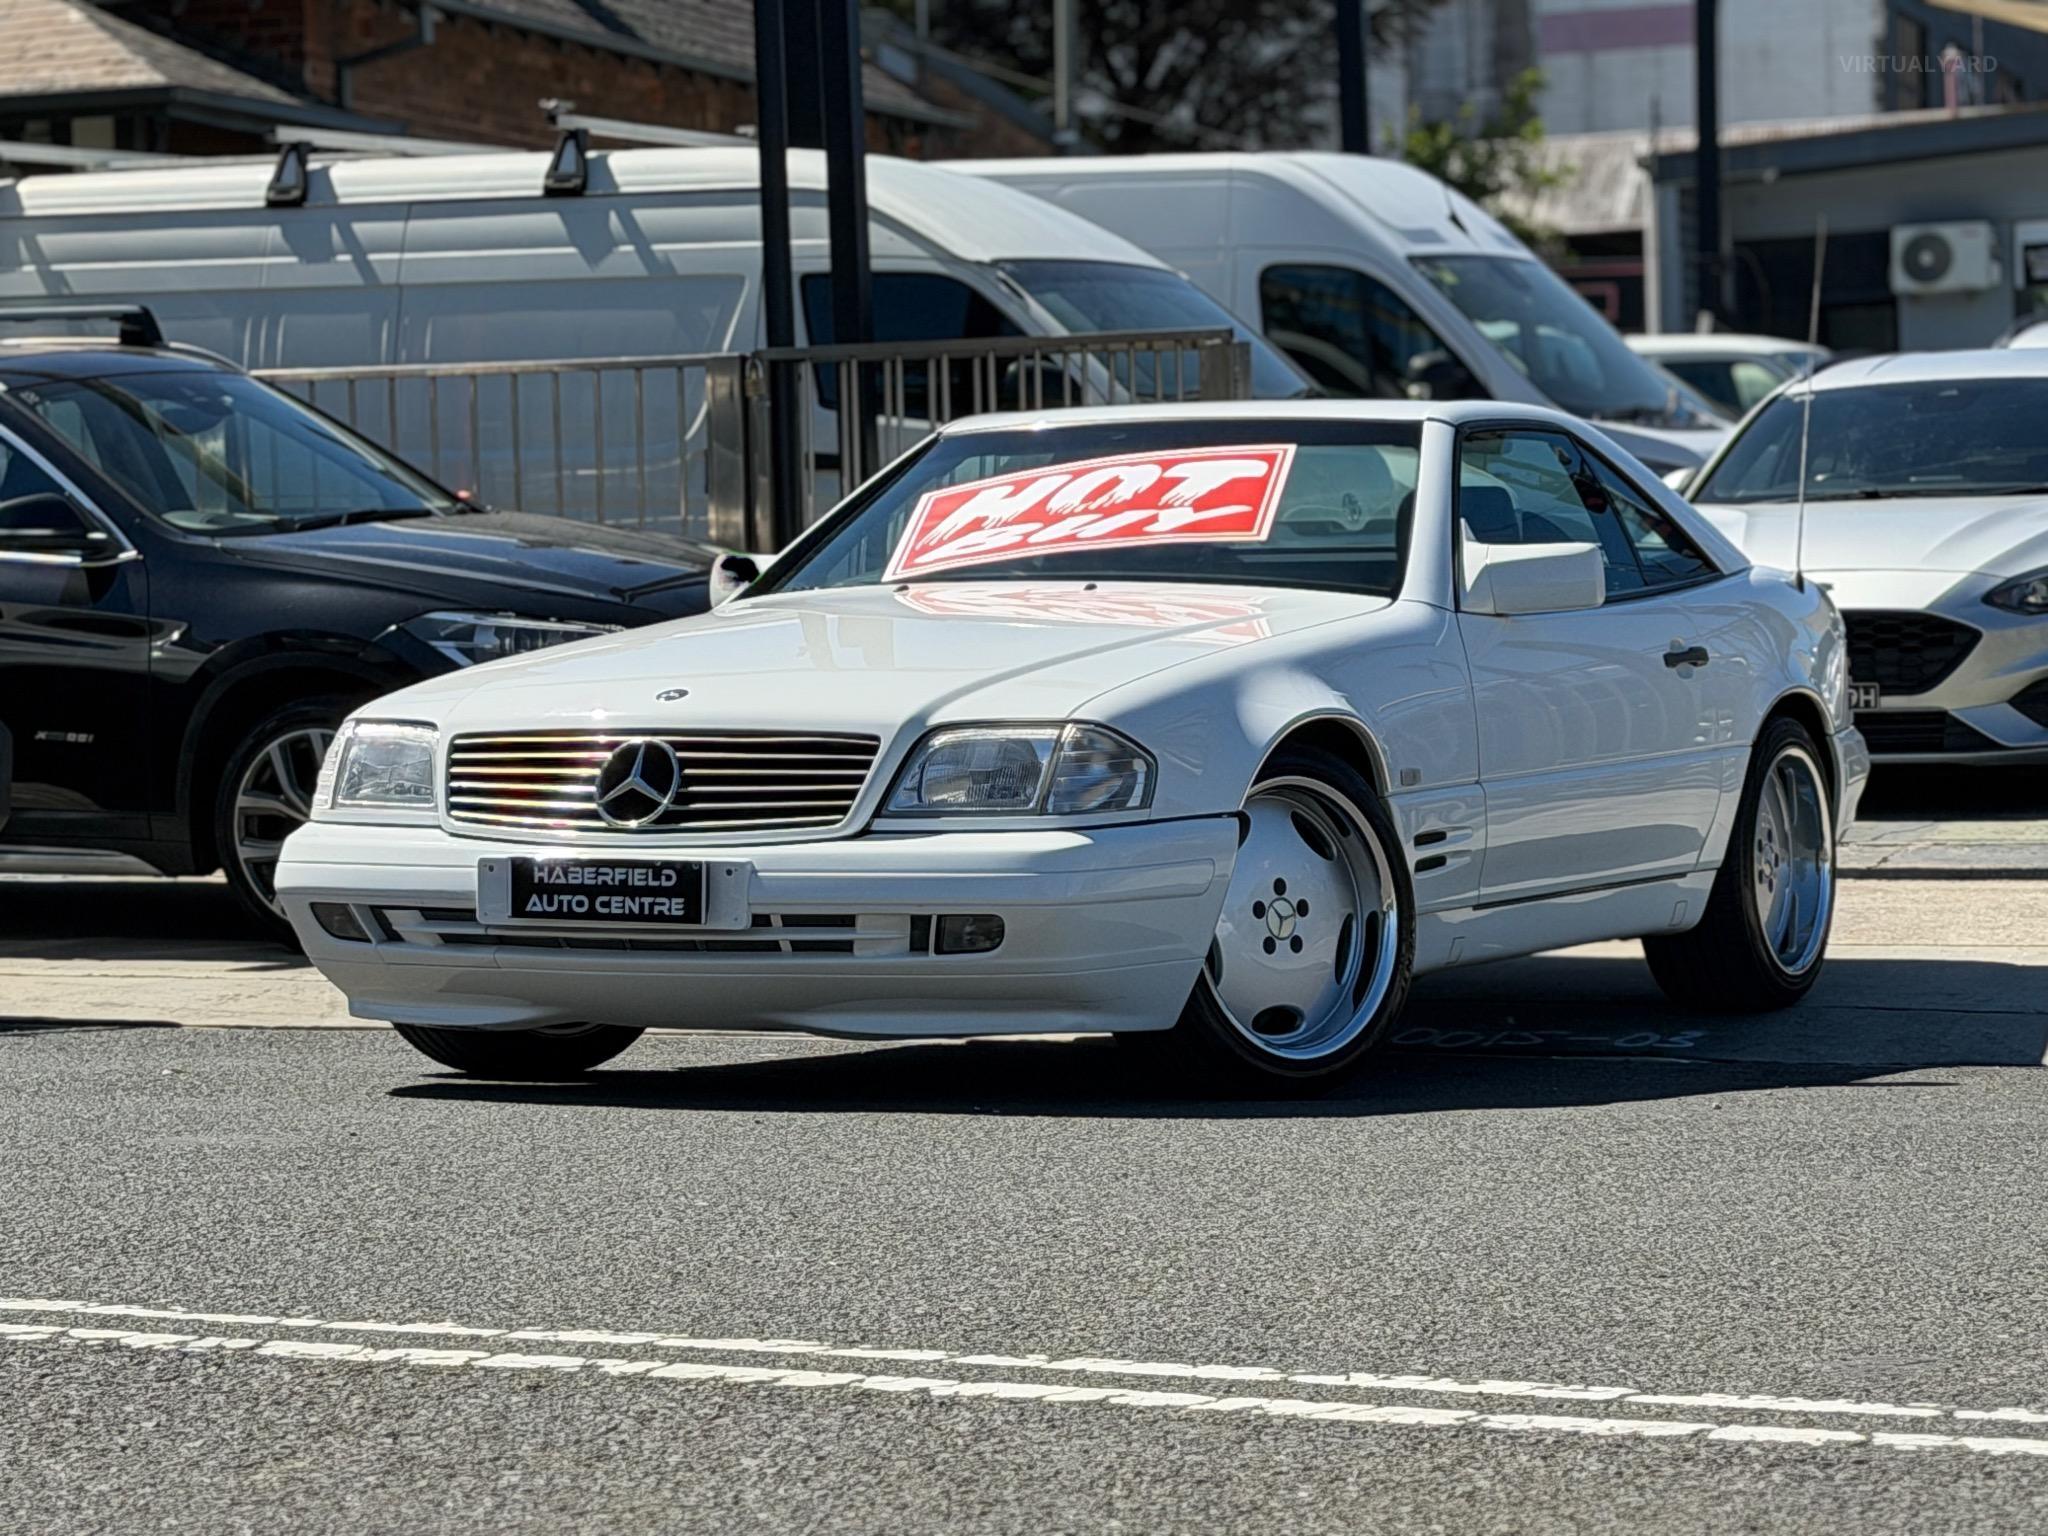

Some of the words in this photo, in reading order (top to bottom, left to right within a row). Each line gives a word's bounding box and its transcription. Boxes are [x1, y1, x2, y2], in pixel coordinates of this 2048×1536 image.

[915, 459, 1269, 550] HOT
[914, 505, 1254, 564] BUY
[533, 866, 678, 888] HABERFIELD
[525, 893, 590, 913] AUTO
[594, 895, 686, 916] CENTRE
